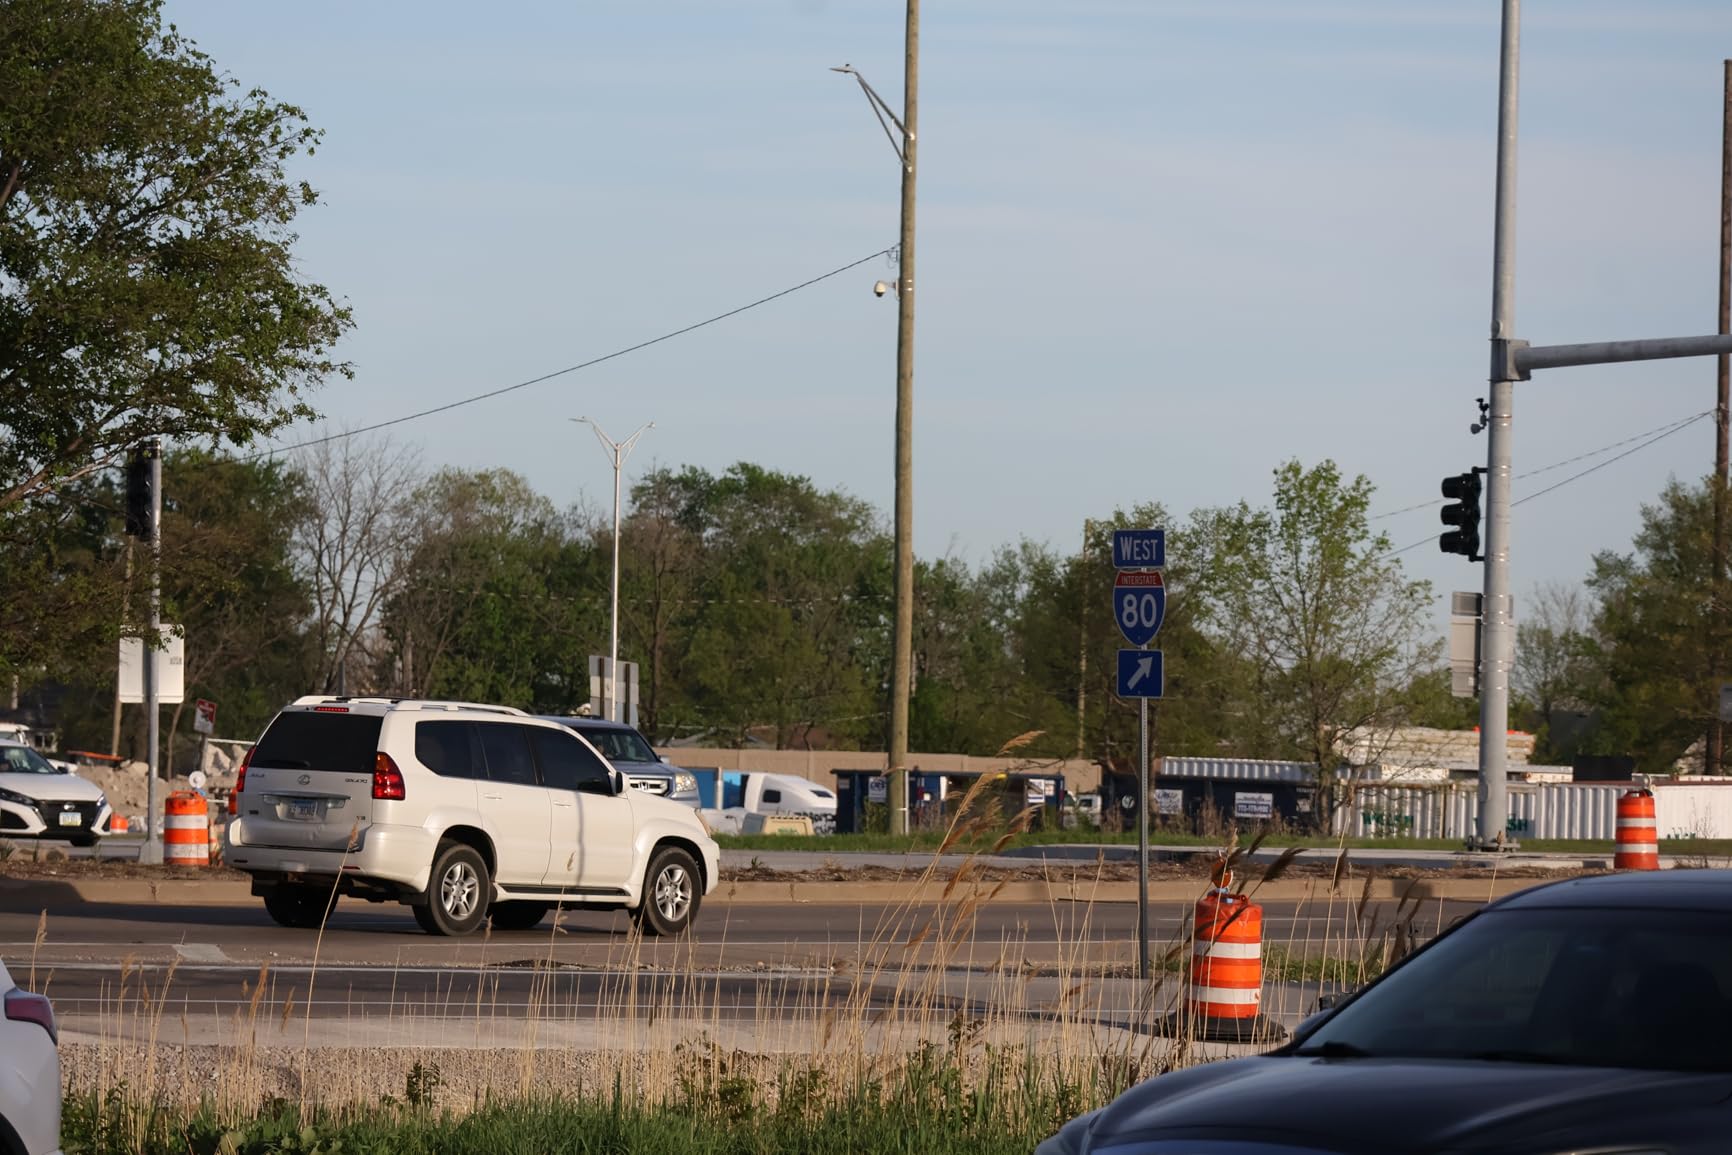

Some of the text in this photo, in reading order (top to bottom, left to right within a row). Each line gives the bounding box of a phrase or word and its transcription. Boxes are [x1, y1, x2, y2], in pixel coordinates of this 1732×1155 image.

[1120, 536, 1158, 560] WEST
[1121, 576, 1157, 585] INTERSTATE
[1122, 594, 1157, 628] 80
